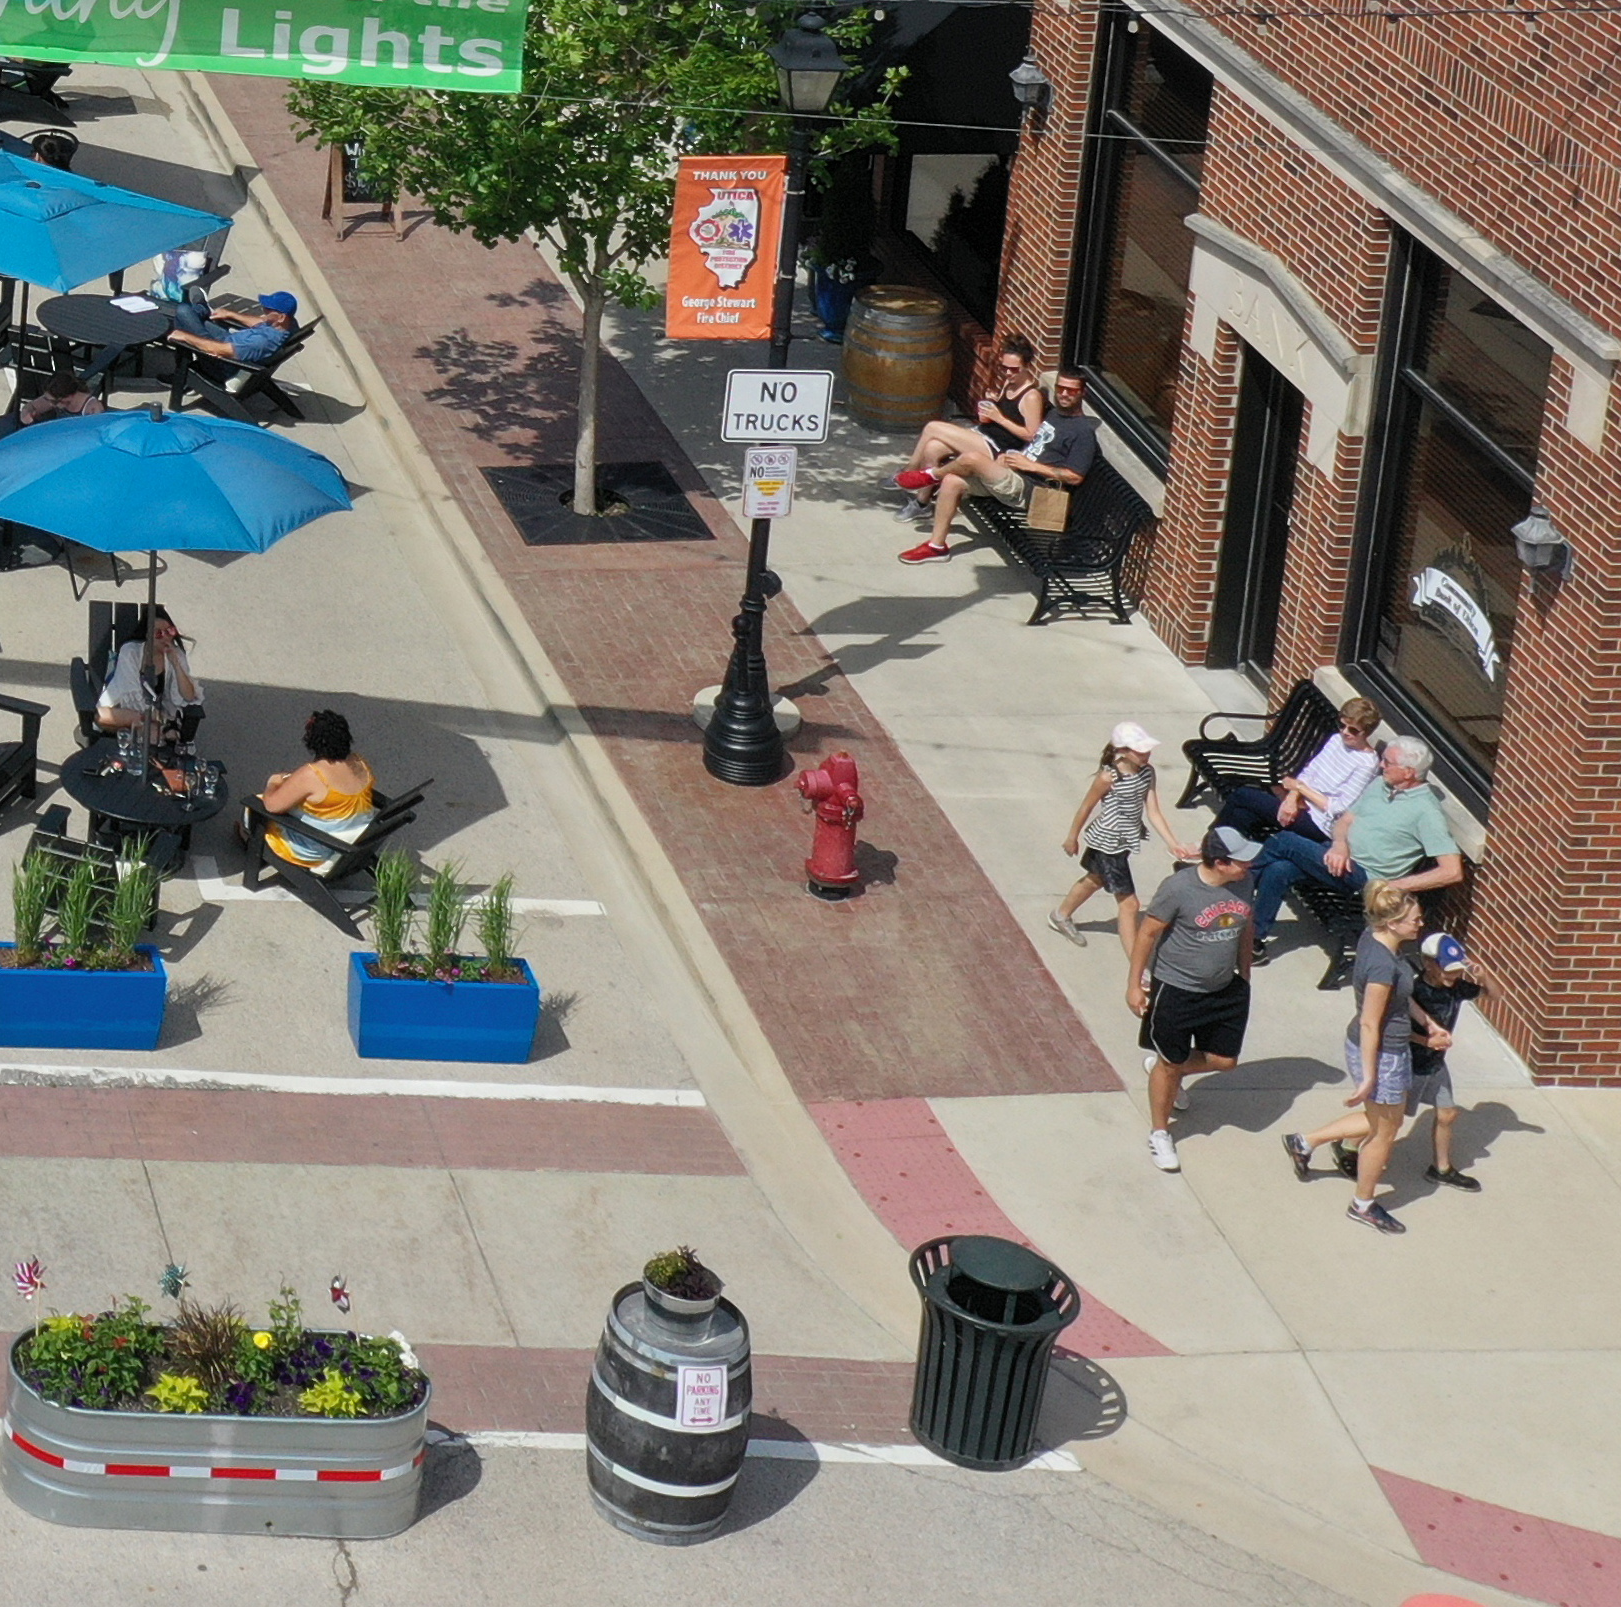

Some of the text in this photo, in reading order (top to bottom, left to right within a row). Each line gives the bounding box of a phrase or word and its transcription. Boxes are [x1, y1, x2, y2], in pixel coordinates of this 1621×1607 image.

[219, 7, 505, 77] Lights
[692, 171, 767, 181] THANK YOU
[716, 190, 754, 201] UTICA
[681, 295, 756, 310] George Stewart
[696, 312, 740, 324] Fire Chief
[760, 381, 797, 404] NO
[733, 412, 819, 432] TRUCKS
[749, 466, 765, 479] NO
[696, 1372, 712, 1384] NO
[686, 1385, 720, 1396] PARKING
[694, 1397, 711, 1405] ANY
[693, 1406, 711, 1415] TIME
